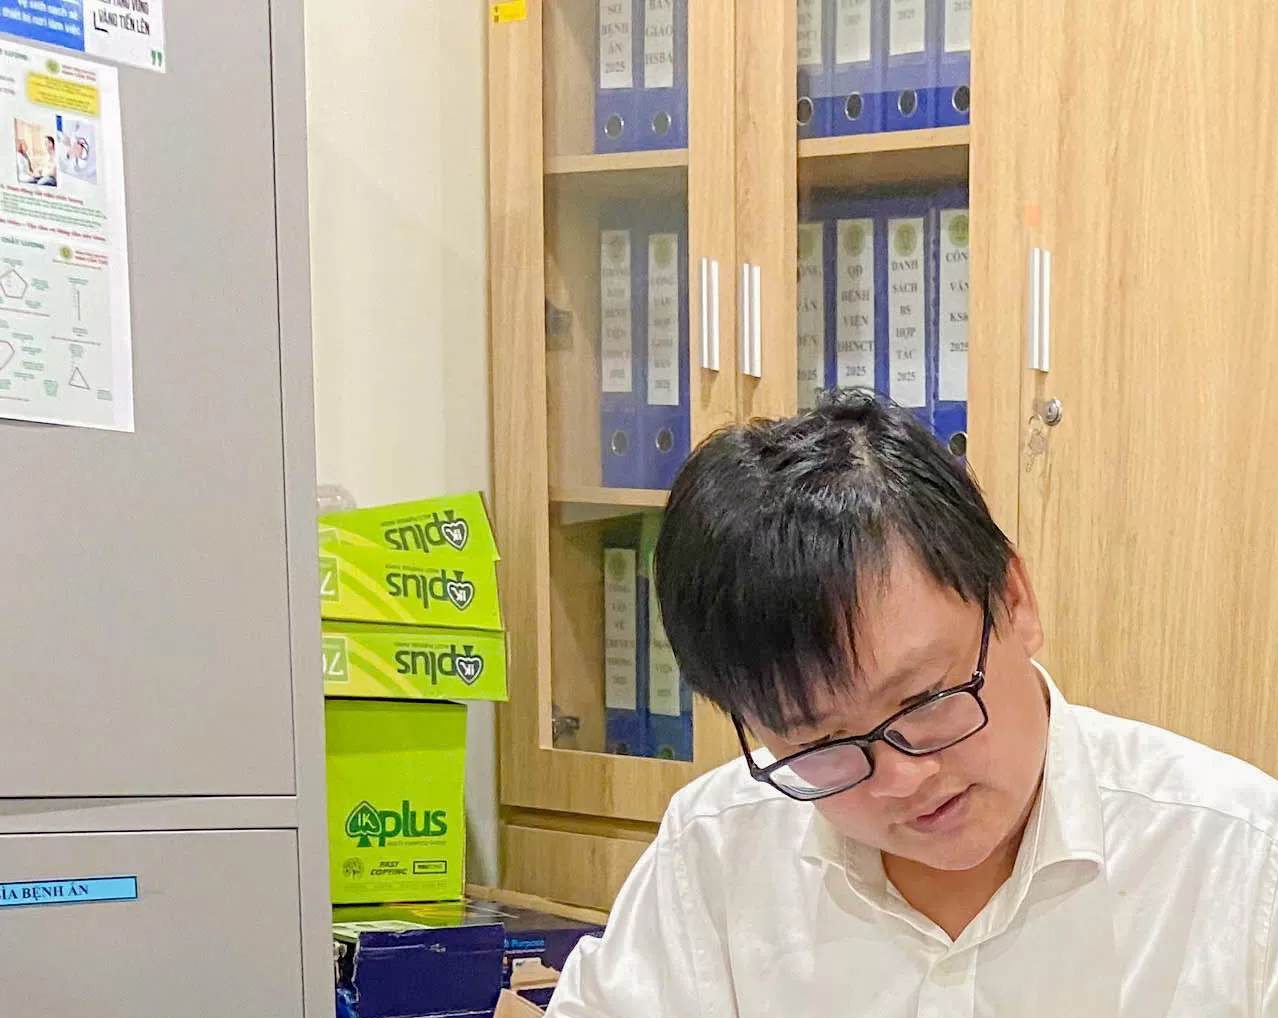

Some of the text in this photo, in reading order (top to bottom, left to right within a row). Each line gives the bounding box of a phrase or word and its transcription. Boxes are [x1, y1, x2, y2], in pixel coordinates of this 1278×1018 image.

[136, 16, 150, 36] LÊN
[891, 259, 919, 272] DANH
[841, 287, 870, 303] BỆNH
[842, 314, 869, 329] VIỆN
[846, 365, 866, 377] 2025
[896, 371, 917, 382] 2025
[384, 512, 446, 553] plus
[386, 569, 448, 609] plus
[394, 645, 457, 686] plus
[378, 800, 448, 848] plus
[0, 882, 89, 901] ÌA BỆNH ÁN
